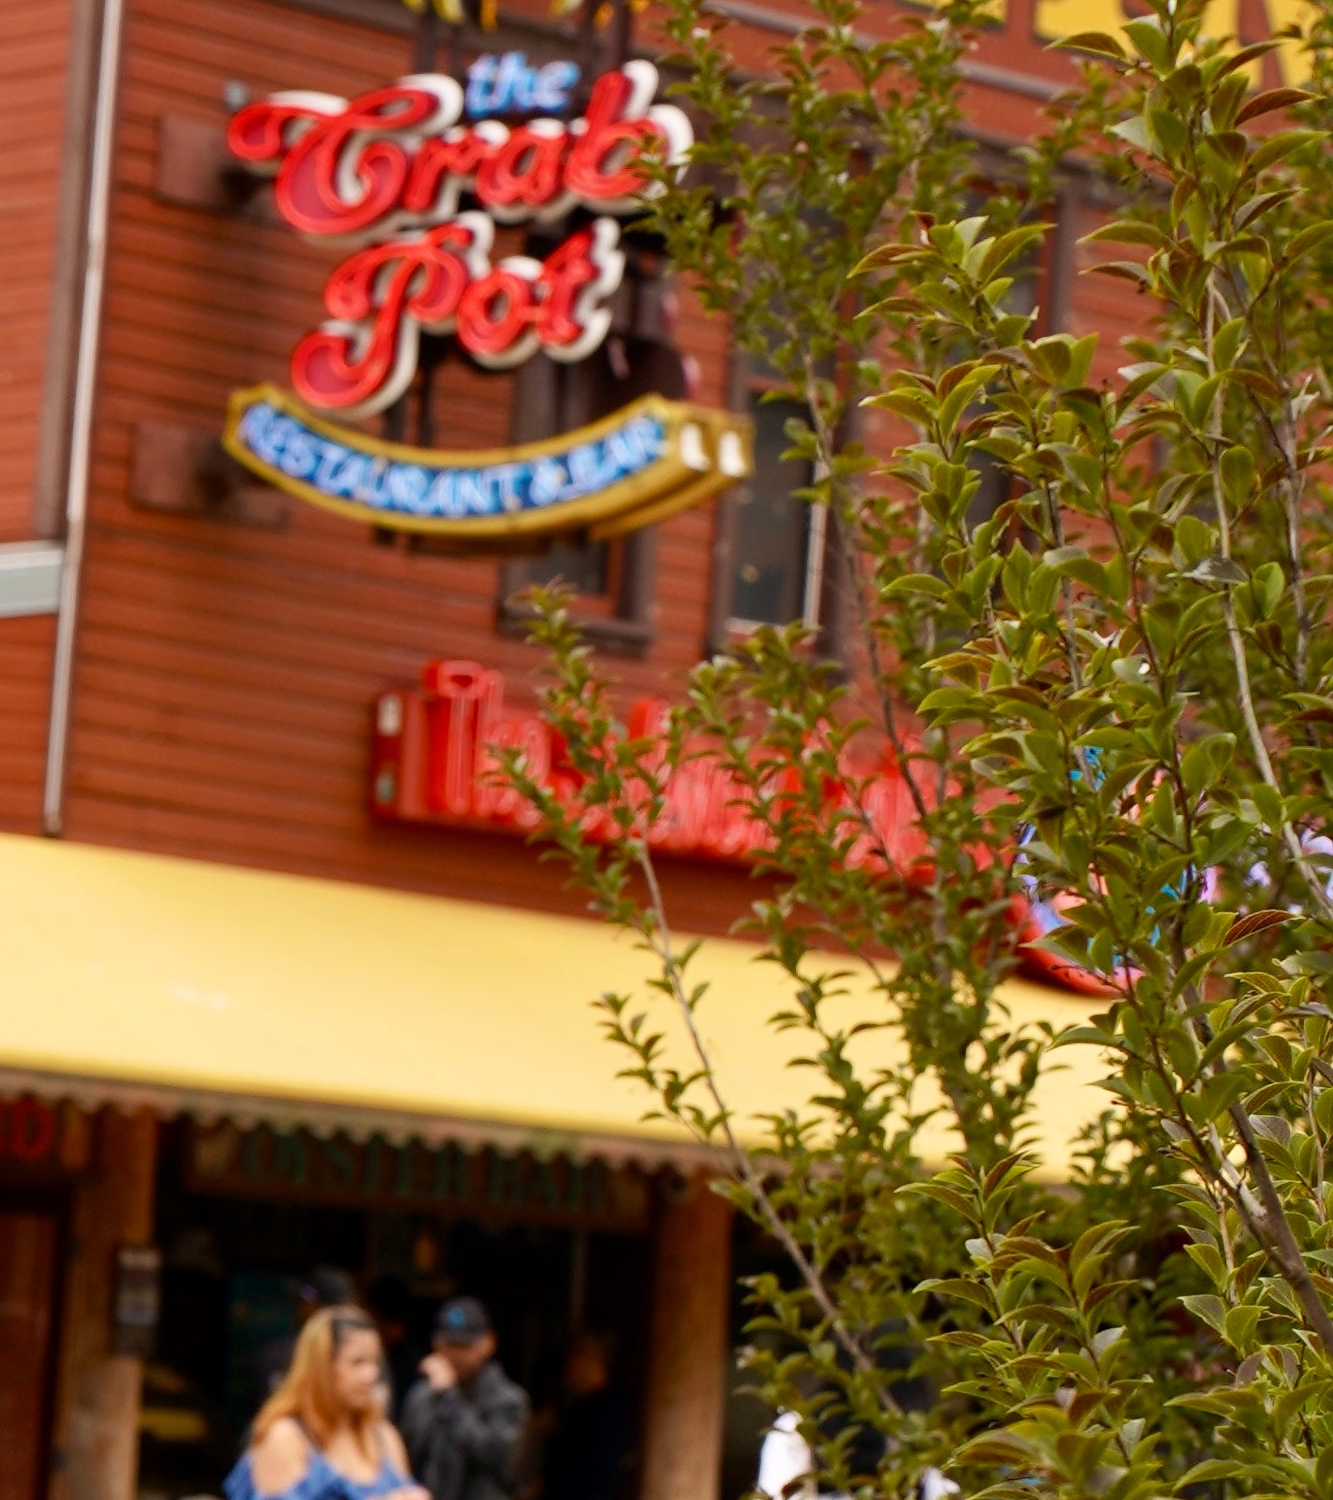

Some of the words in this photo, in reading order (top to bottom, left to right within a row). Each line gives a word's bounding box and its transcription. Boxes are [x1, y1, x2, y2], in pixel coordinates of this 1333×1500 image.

[226, 60, 685, 242] Crab
[465, 50, 581, 122] the
[290, 214, 621, 408] Pot
